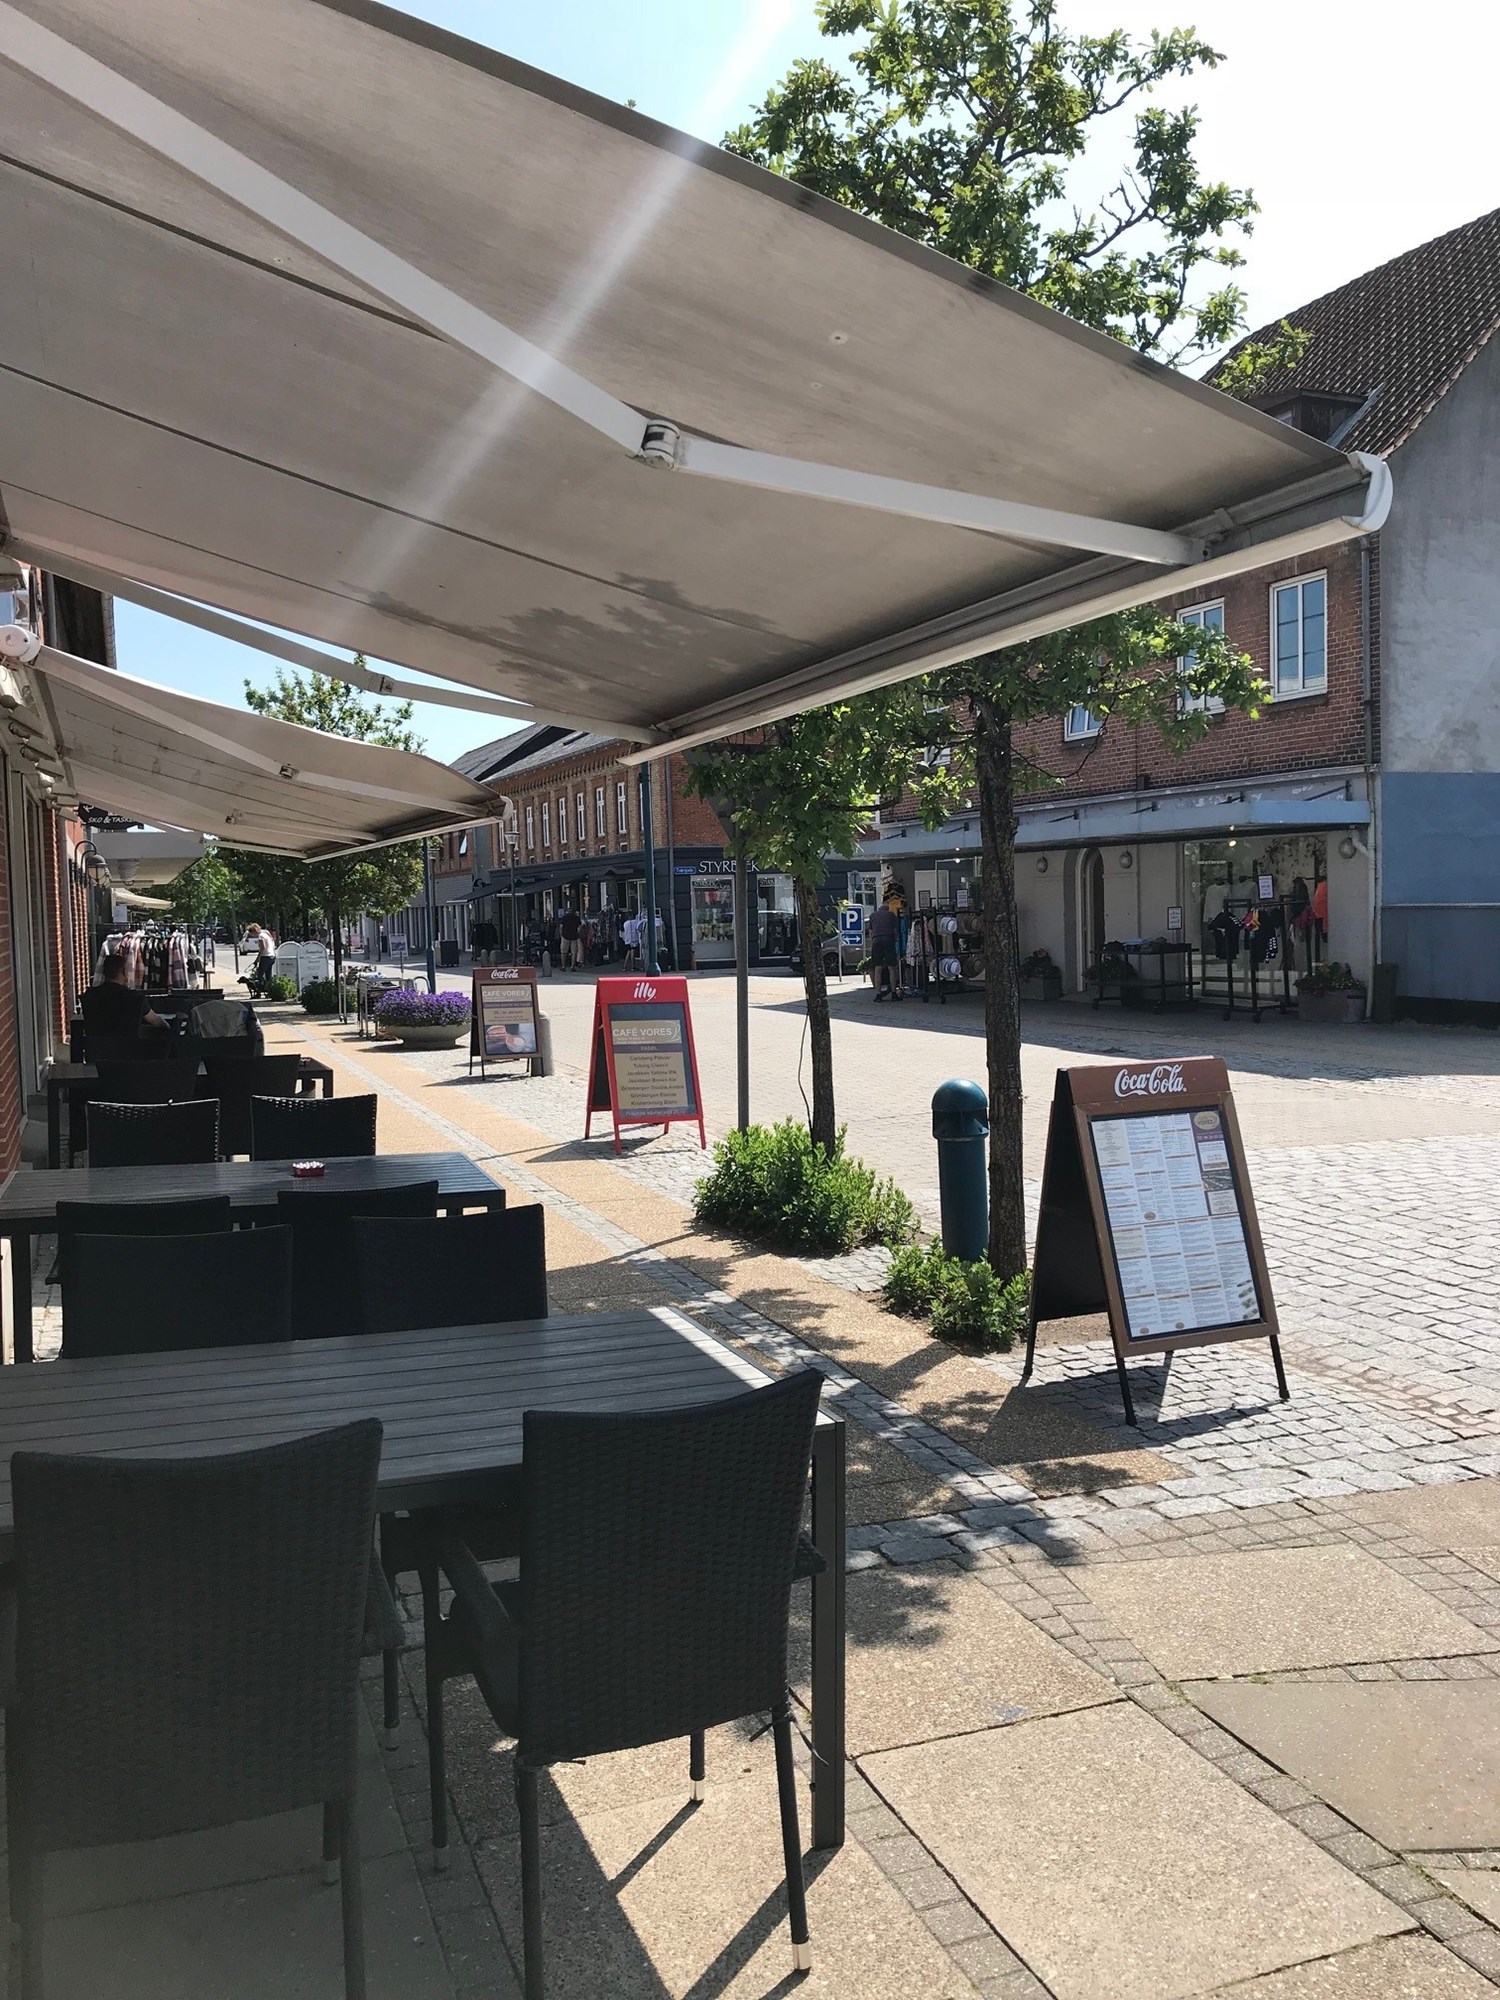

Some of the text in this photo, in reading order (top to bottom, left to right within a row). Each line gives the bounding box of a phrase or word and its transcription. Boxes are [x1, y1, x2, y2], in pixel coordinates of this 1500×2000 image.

[88, 816, 103, 824] SKO
[103, 816, 111, 824] &
[846, 910, 858, 929] P
[633, 982, 657, 1002] illy
[640, 1027, 672, 1037] VORES
[1114, 1064, 1187, 1097] Coca-Cola
